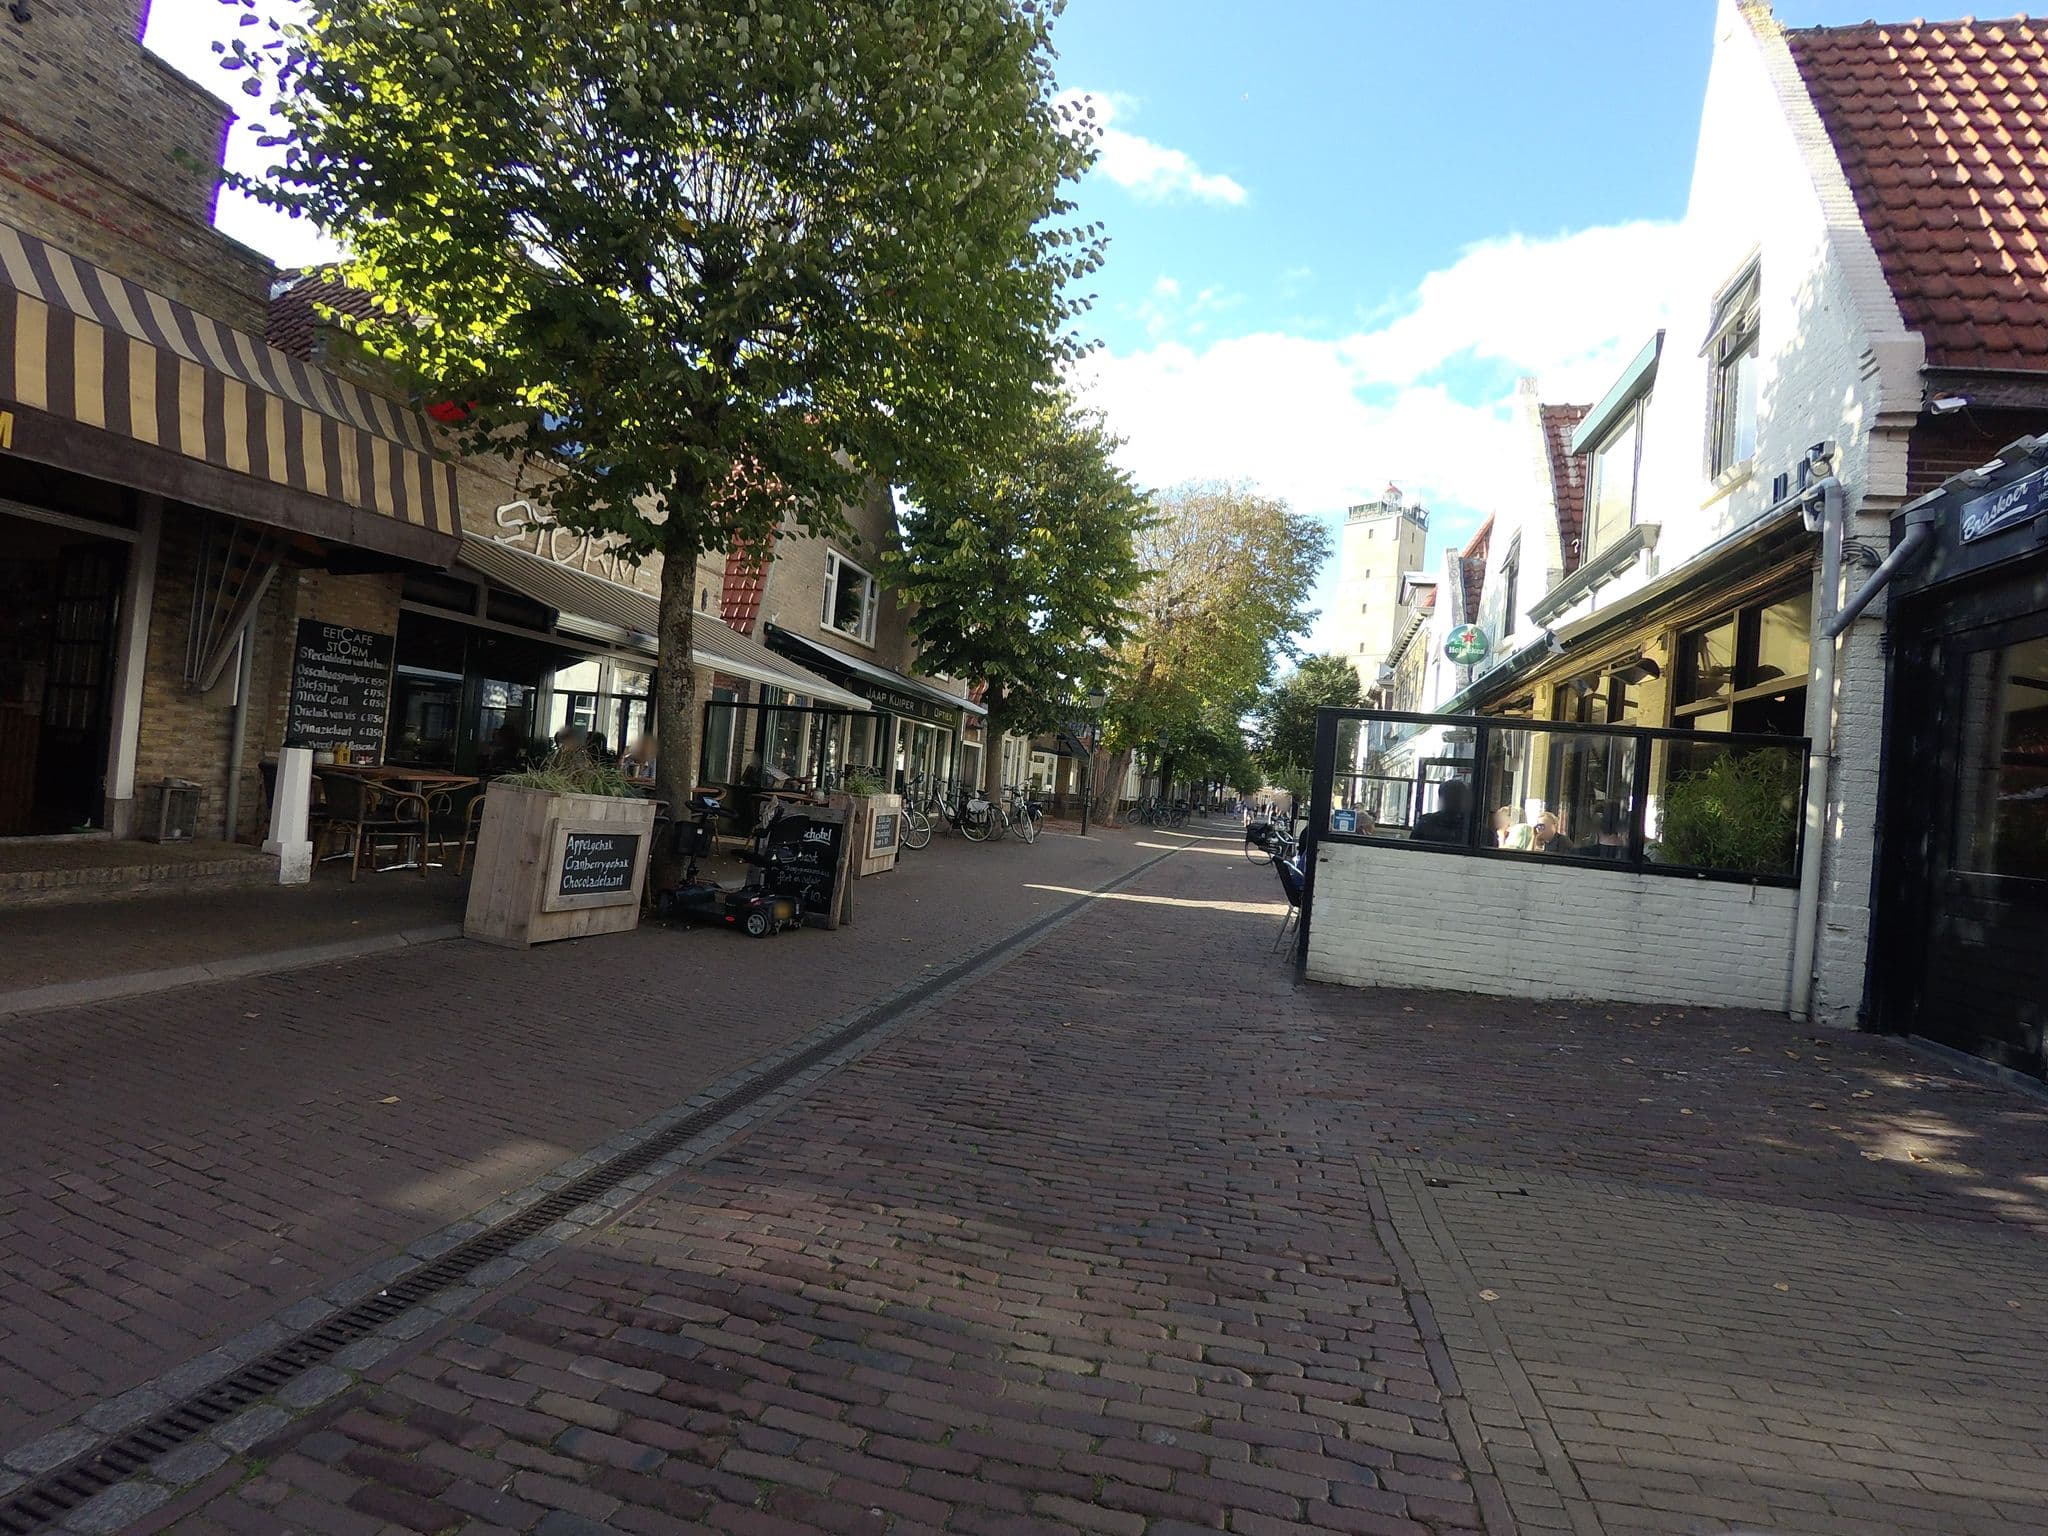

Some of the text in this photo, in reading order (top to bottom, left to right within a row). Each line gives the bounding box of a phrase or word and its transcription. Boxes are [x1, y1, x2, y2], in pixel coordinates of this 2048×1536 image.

[322, 627, 374, 646] EETCAFE
[326, 640, 369, 658] STORM
[296, 690, 328, 704] Mixed
[866, 687, 887, 702] JAAP
[889, 693, 915, 711] KUIPER
